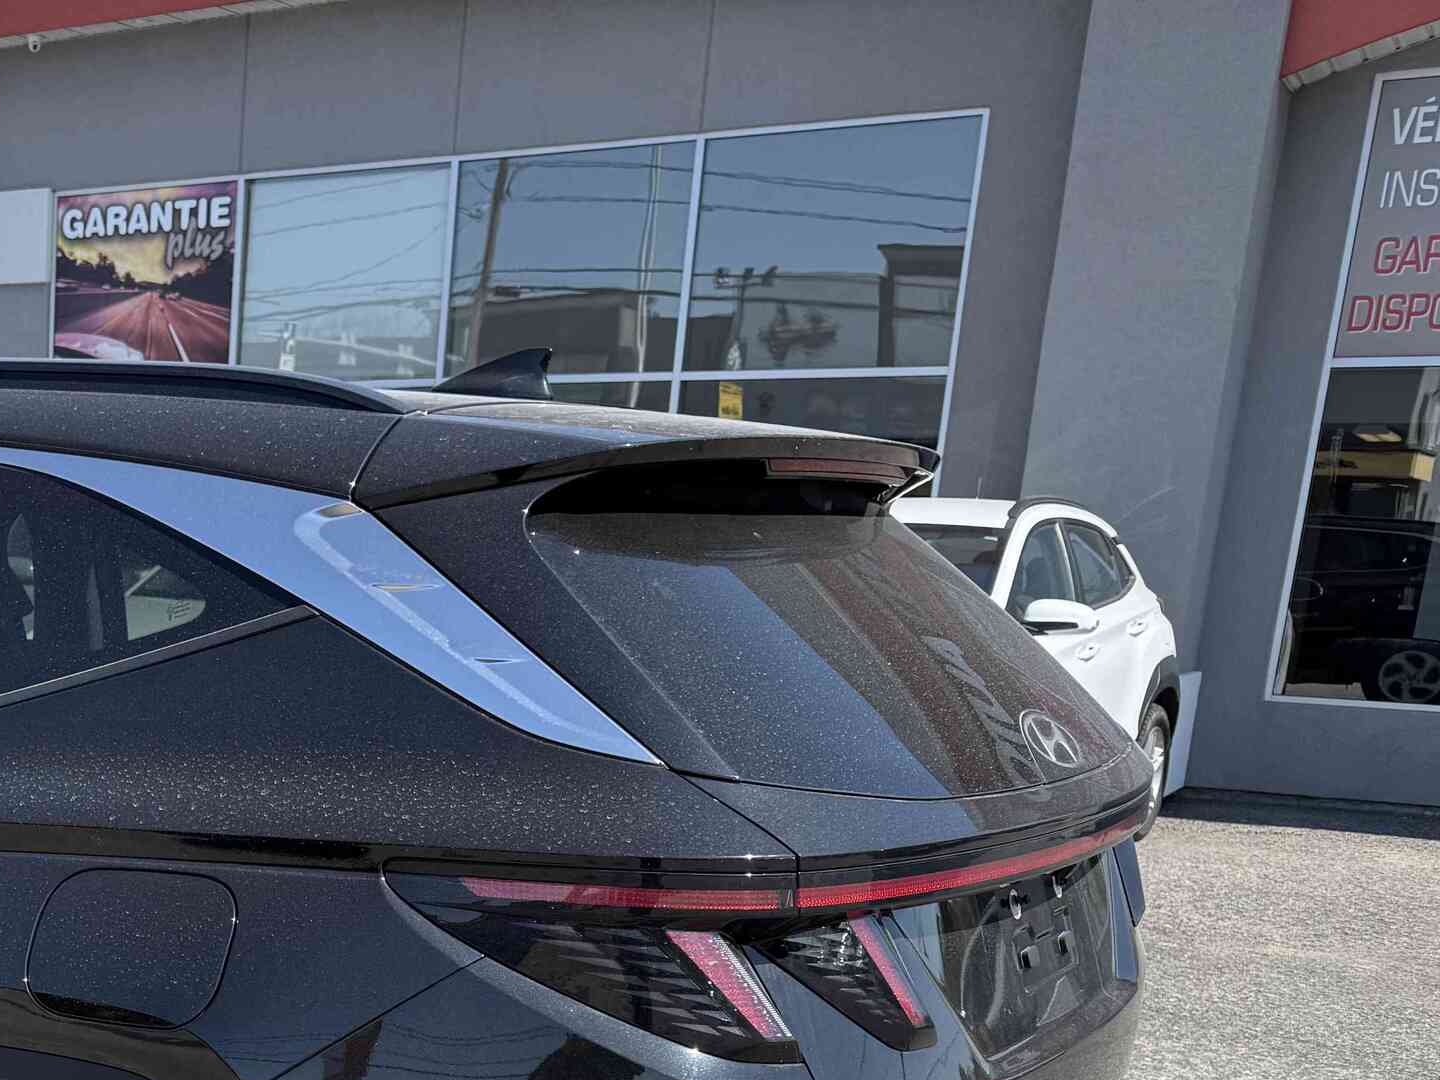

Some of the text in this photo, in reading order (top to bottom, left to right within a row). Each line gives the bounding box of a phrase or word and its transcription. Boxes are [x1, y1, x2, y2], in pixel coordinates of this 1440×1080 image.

[1393, 96, 1440, 144] VÉ
[62, 196, 231, 240] GARANTIE
[166, 218, 226, 271] plus
